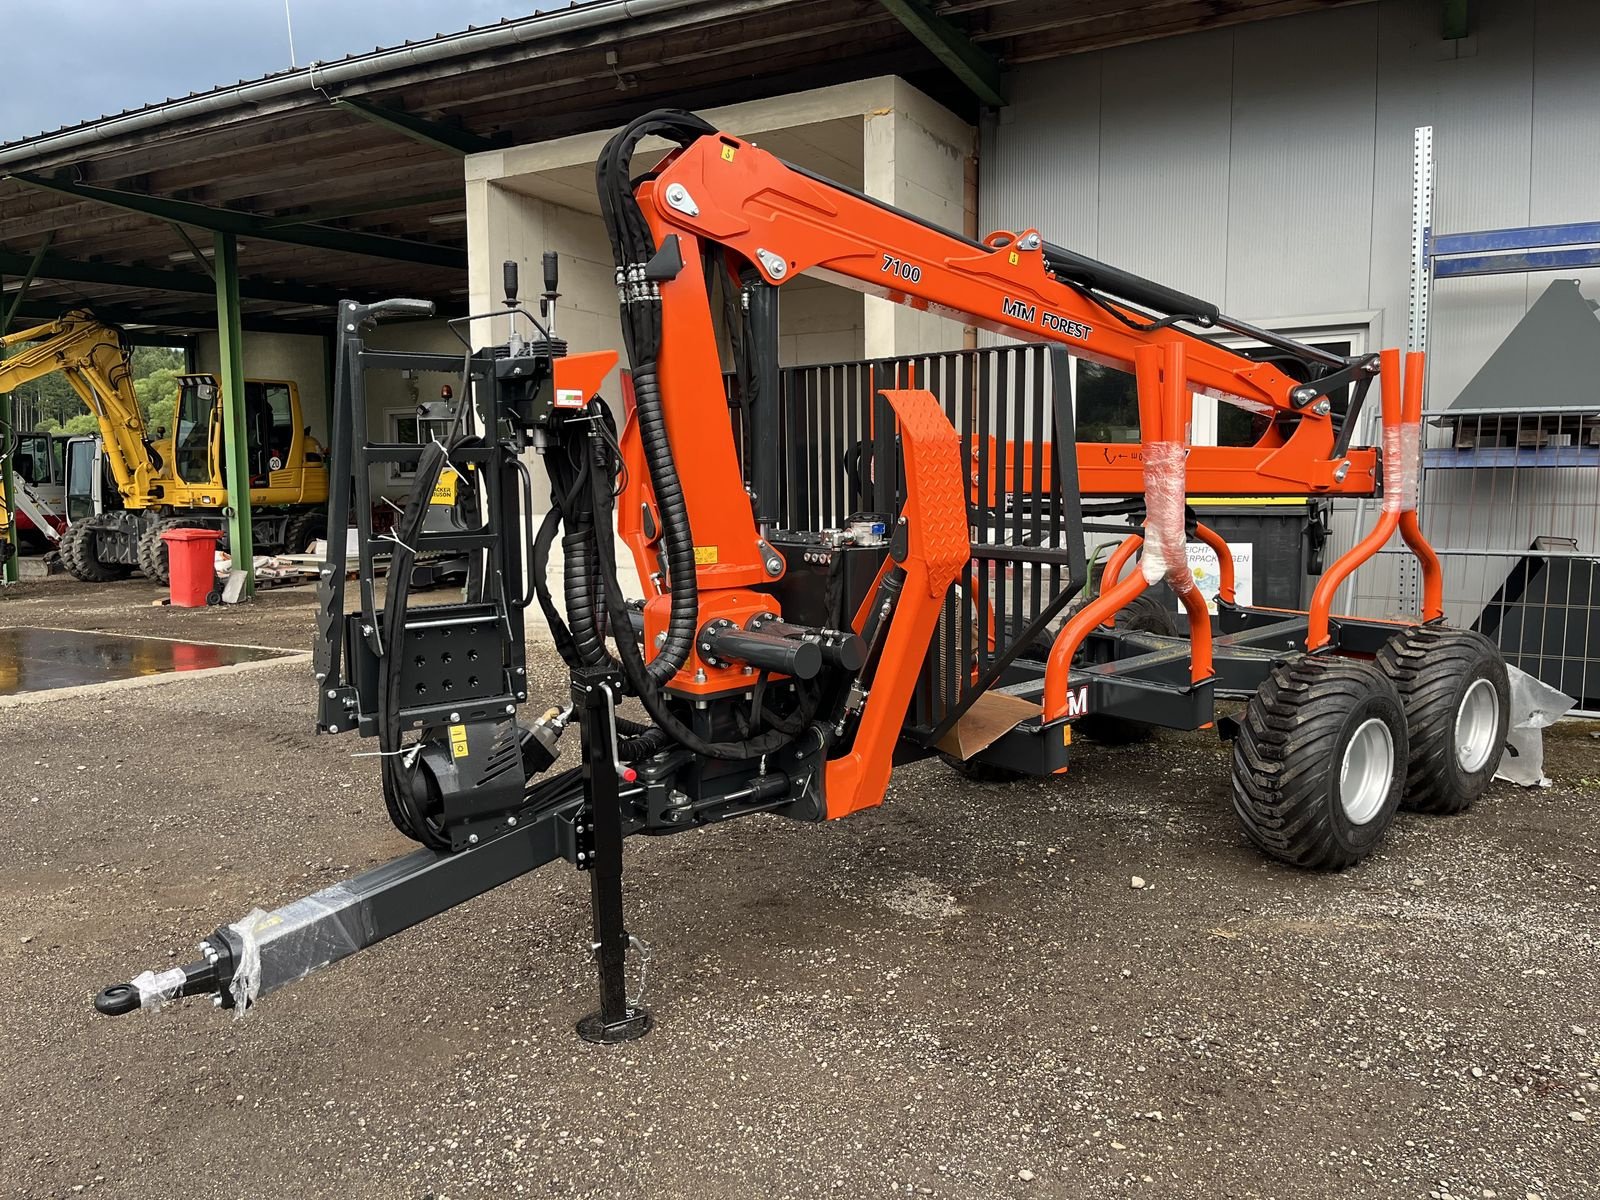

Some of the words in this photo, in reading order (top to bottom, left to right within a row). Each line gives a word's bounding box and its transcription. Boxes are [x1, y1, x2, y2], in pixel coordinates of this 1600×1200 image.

[882, 254, 921, 283] 7100
[1002, 296, 1036, 323] MTM
[1041, 311, 1092, 340] FOREST
[271, 459, 280, 468] 20
